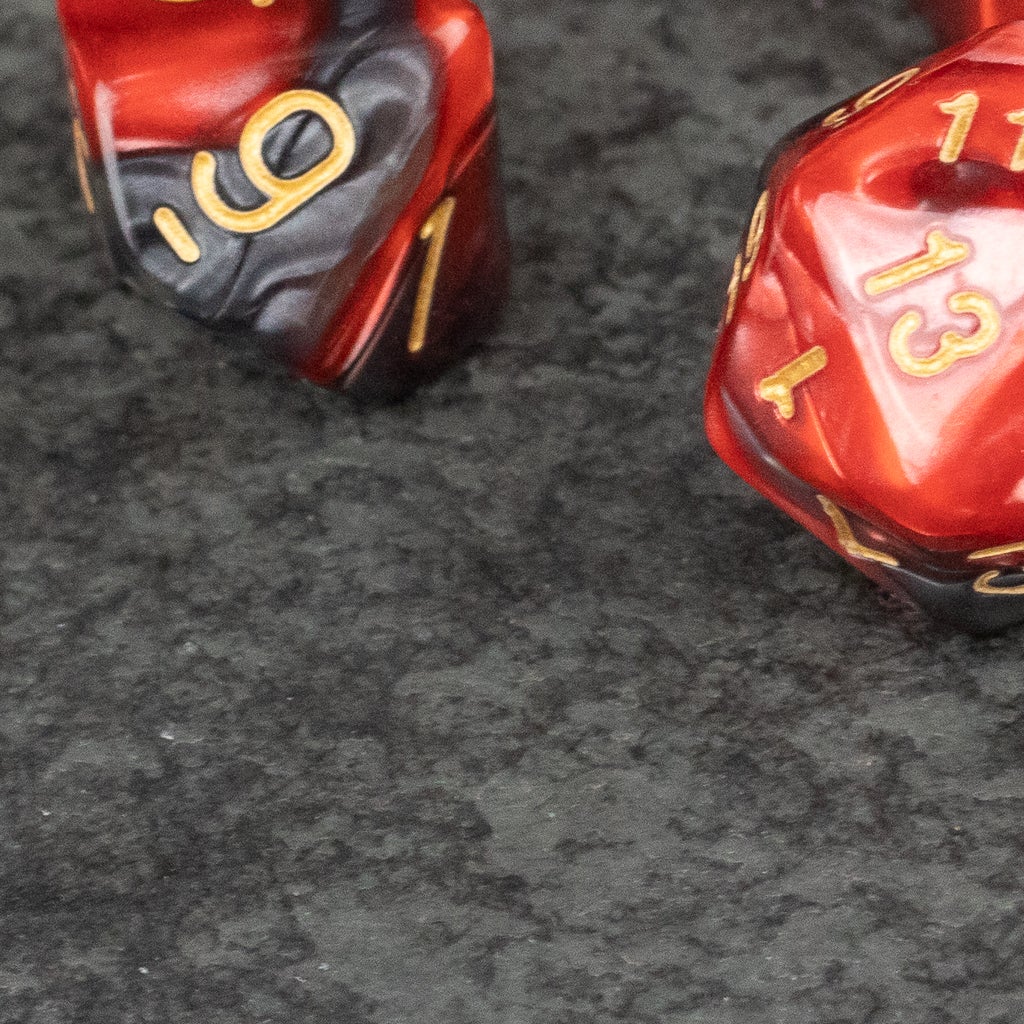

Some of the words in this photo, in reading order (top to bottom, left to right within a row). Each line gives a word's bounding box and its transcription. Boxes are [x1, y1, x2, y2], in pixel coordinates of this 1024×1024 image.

[406, 195, 458, 354] 1
[863, 228, 1003, 379] 13
[758, 343, 830, 421] 1
